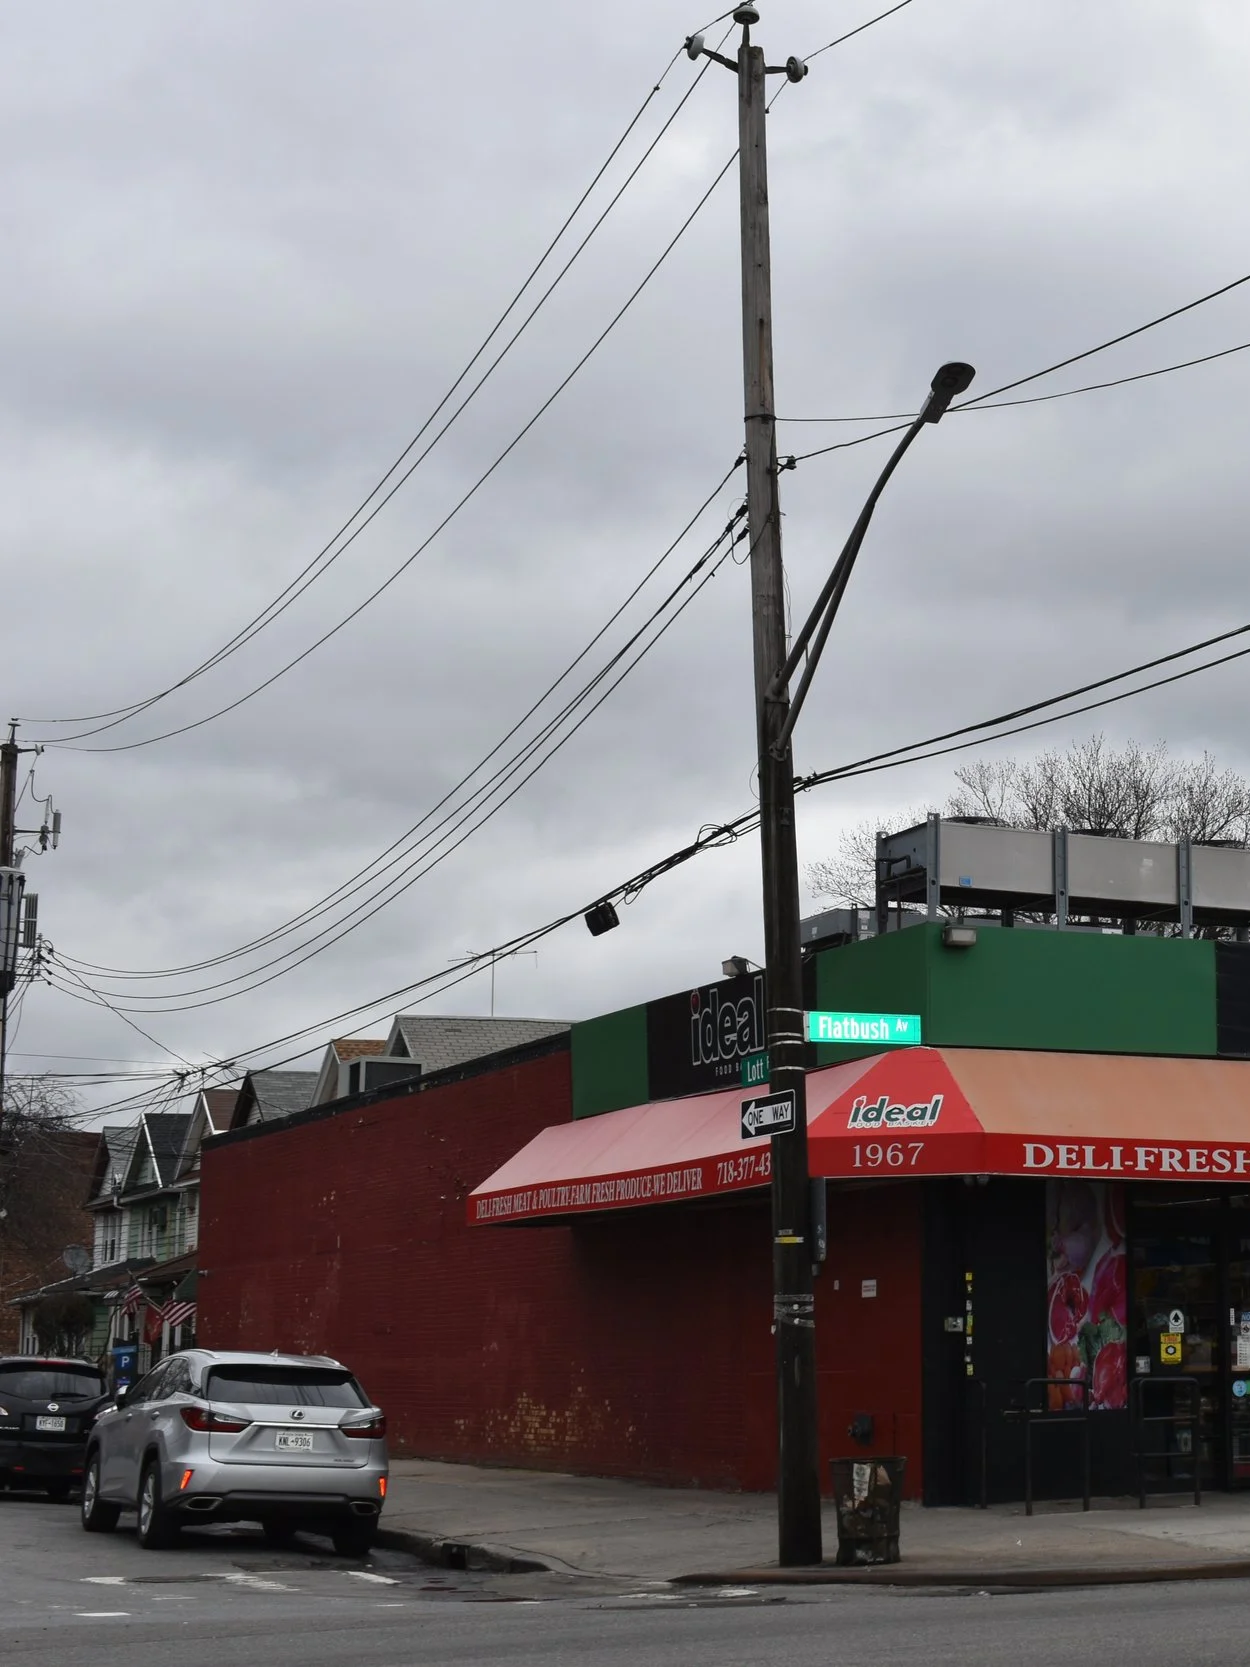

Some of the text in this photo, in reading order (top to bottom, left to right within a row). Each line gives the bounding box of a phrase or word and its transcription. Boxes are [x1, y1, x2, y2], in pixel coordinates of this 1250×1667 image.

[690, 976, 765, 1066] ideal
[818, 1016, 908, 1040] Flatbush Av
[715, 1066, 732, 1076] FOOD
[747, 1058, 764, 1082] Lott
[748, 1104, 790, 1126] ONE WAY
[849, 1095, 944, 1124] ideal
[852, 1142, 924, 1168] 1967
[476, 1152, 770, 1219] DELI-FRESH MEAT & POULTRY-FARM FRESH PRODUCE-WE DELIVER 718-377-43
[121, 1356, 130, 1368] P
